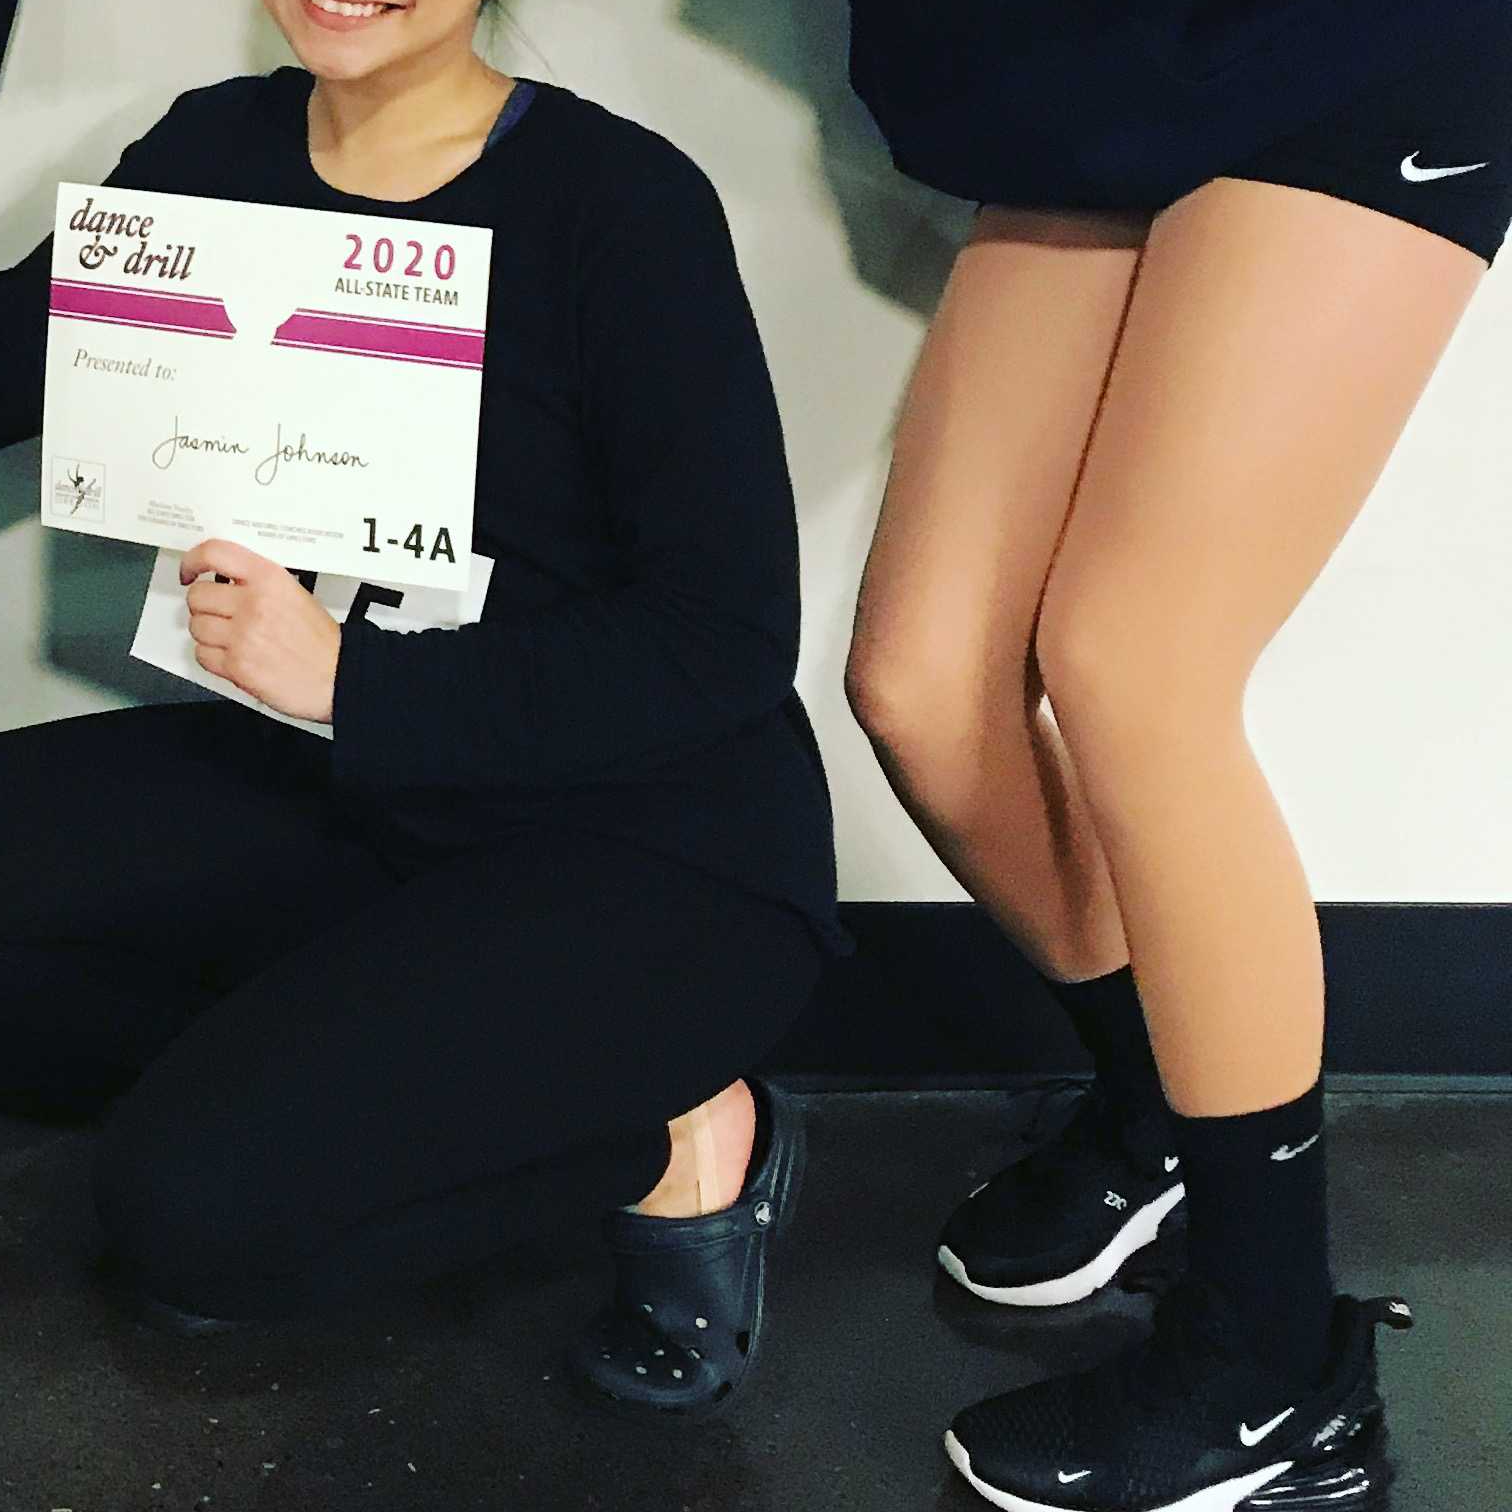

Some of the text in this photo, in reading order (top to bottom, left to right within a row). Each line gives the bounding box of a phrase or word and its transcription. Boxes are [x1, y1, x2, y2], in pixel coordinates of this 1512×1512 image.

[69, 199, 154, 238] dance
[79, 235, 196, 281] & drill
[344, 234, 456, 280] 2020
[335, 277, 459, 306] ALL-STATE TEAM
[73, 348, 177, 381] Presented to:
[152, 415, 369, 486] Jasmin Johnson
[361, 517, 456, 564] 1-4A
